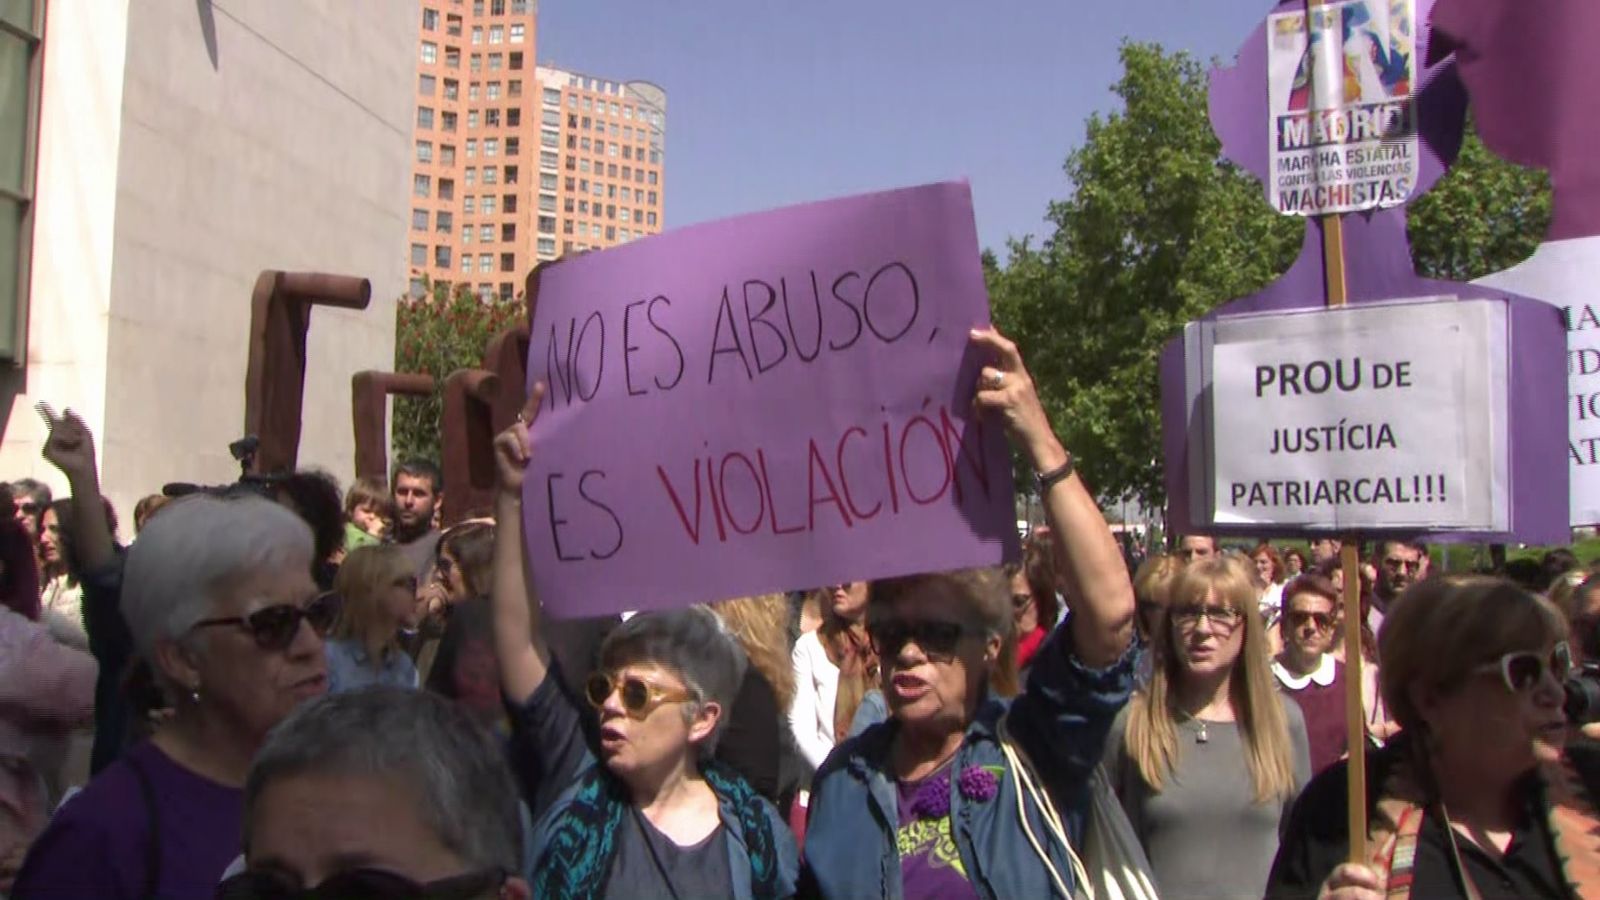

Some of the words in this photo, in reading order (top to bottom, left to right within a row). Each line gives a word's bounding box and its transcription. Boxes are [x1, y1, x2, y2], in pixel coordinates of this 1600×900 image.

[1278, 152, 1341, 171] MARCHA
[1346, 143, 1411, 165] ESTATAL
[1322, 169, 1342, 181] LAS
[1346, 161, 1411, 179] VIOLENCIAS
[1279, 177, 1410, 212] MACHISTAS
[546, 310, 605, 411] NO
[623, 295, 685, 396] ES
[707, 261, 941, 385] ABUSO,
[1255, 356, 1362, 398] PROU
[1371, 361, 1413, 390] DE
[1269, 417, 1397, 454] JUSTÍCIA
[1231, 474, 1447, 507] PATRIARCAL!!!
[547, 469, 624, 562] ES
